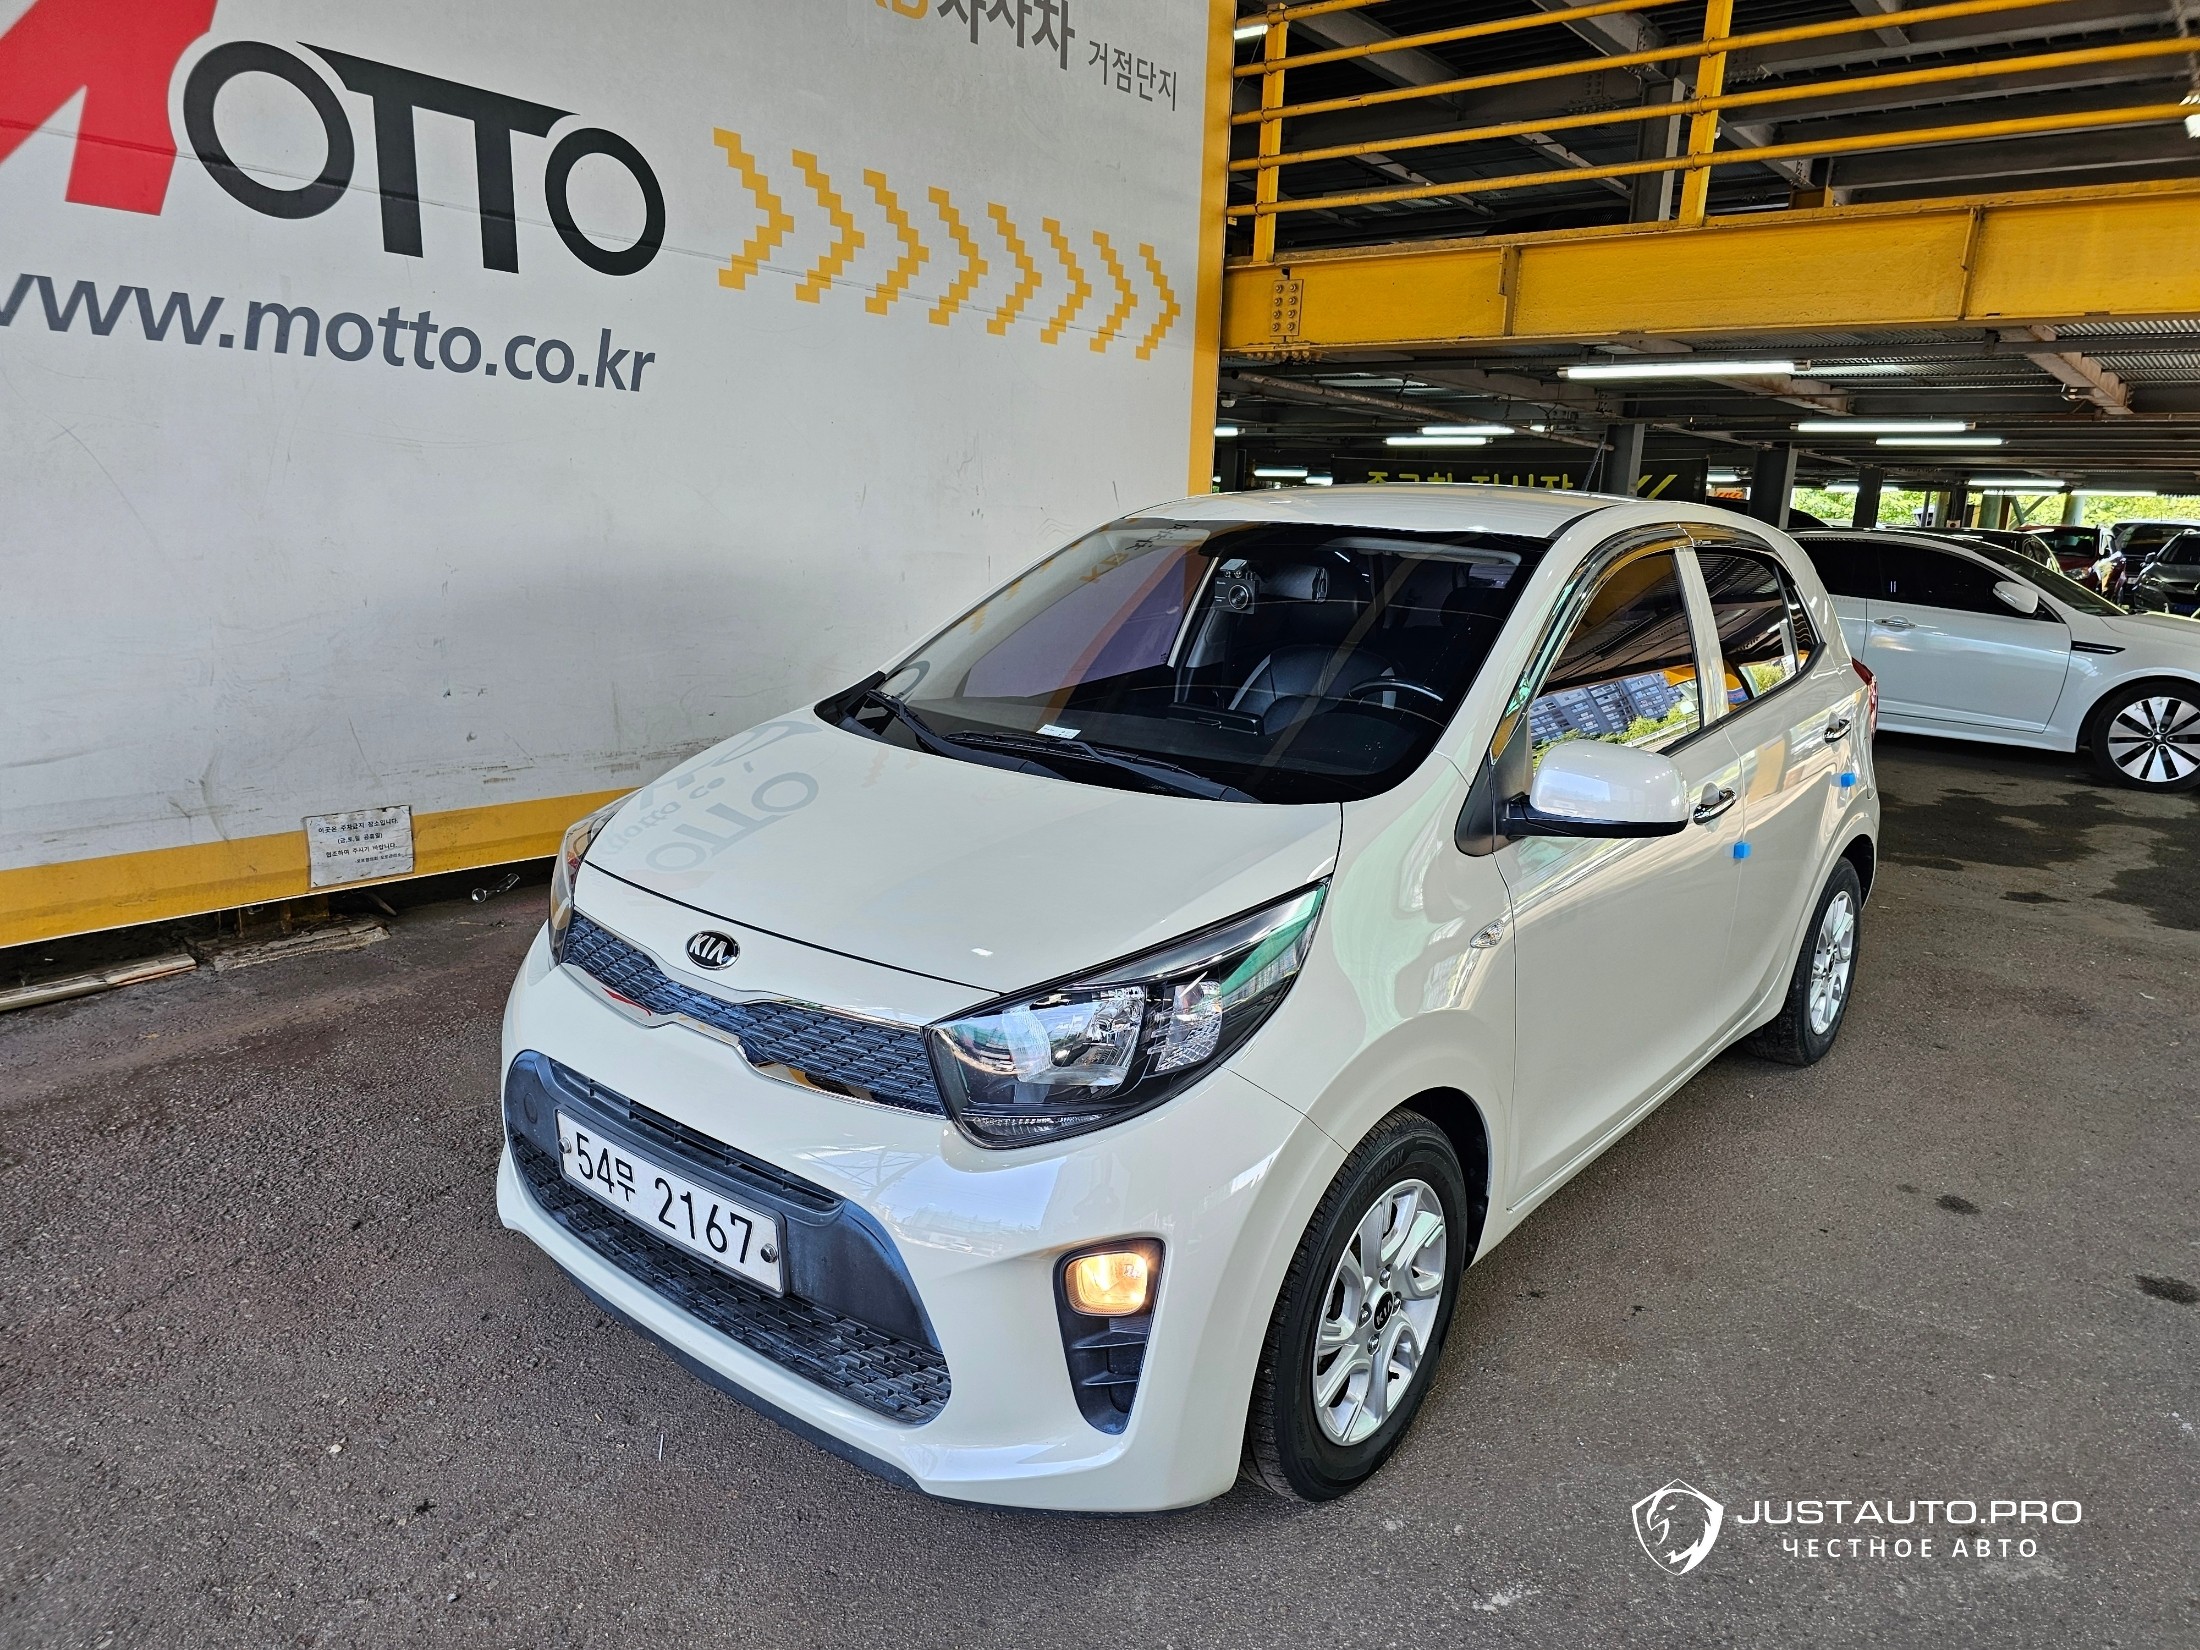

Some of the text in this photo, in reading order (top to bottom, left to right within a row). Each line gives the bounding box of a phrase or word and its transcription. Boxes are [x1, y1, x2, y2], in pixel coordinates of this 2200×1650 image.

[1088, 40, 1177, 112] 거점단지
[689, 932, 728, 966] KIA
[576, 1131, 753, 1264] 54무 2167
